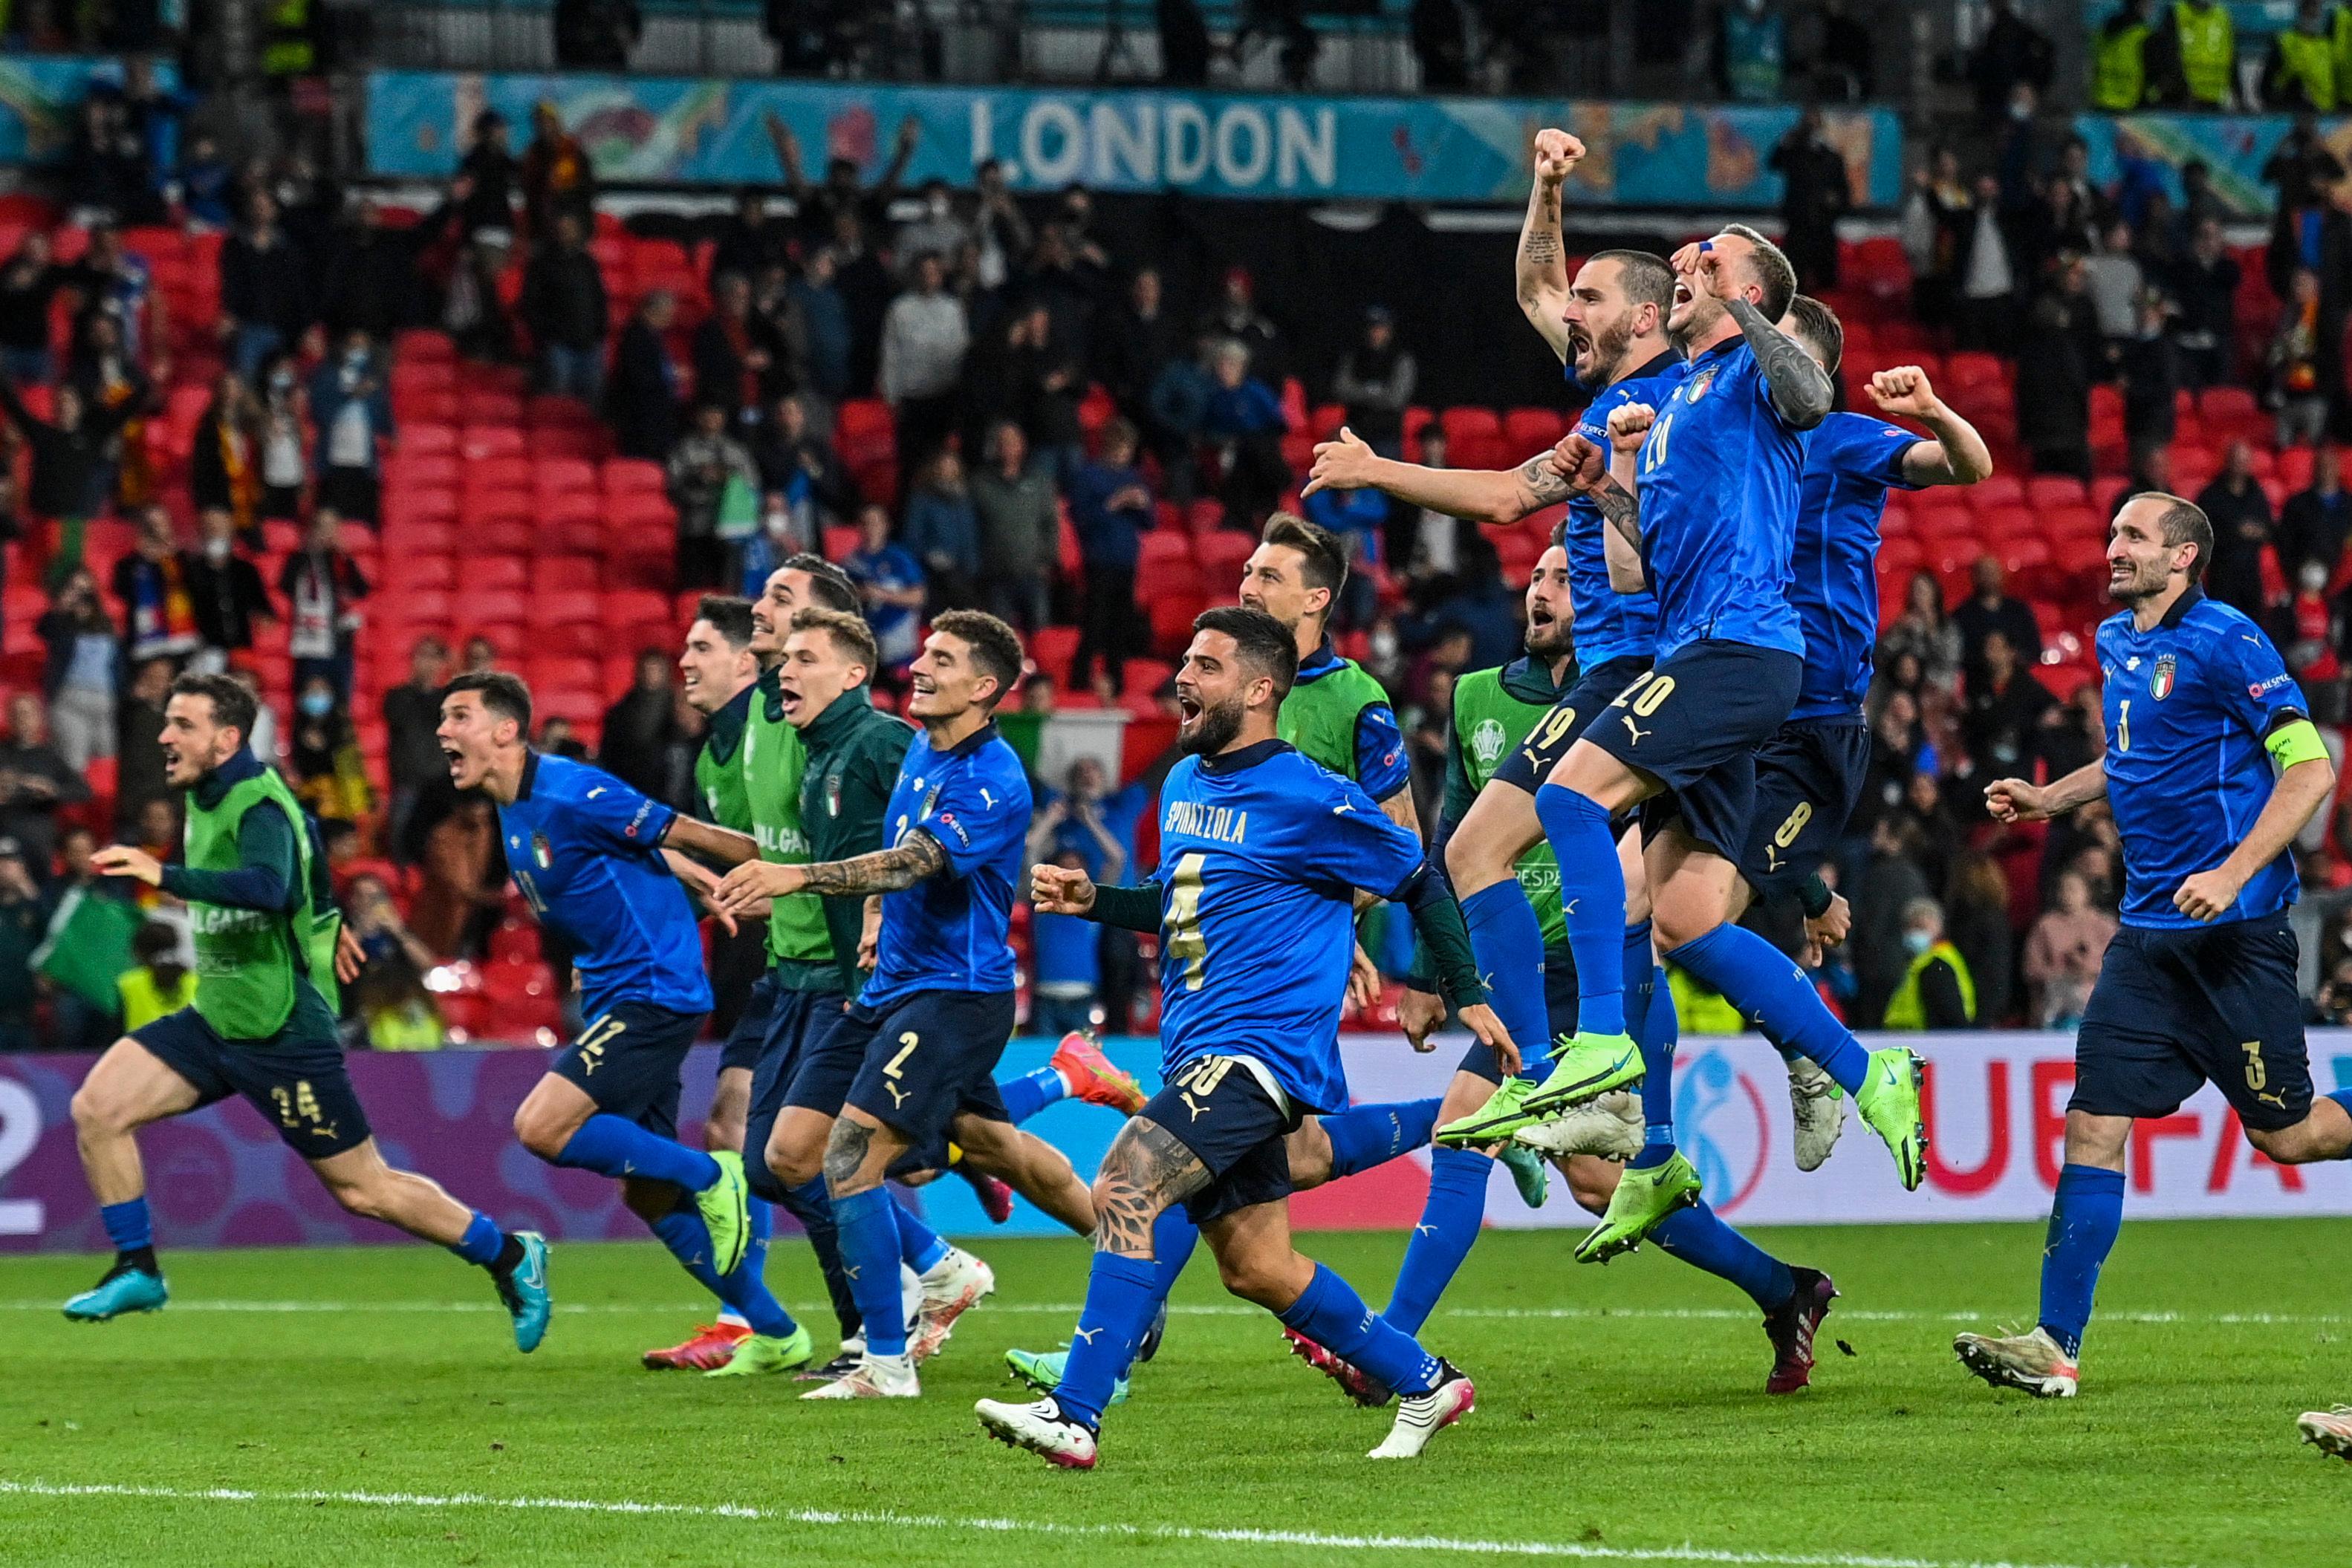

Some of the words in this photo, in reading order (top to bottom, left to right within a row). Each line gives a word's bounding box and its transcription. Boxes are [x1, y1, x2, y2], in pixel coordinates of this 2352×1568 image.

[970, 98, 1335, 187] LONDON
[1645, 413, 1674, 475] 20
[1611, 671, 1675, 717] 20
[1524, 705, 1576, 750] 19
[1775, 801, 1812, 848] 8
[1165, 853, 1207, 991] 4
[576, 1015, 626, 1056] 12
[882, 1031, 919, 1080] 2
[2241, 1041, 2267, 1091] 3
[270, 1081, 322, 1128] 24
